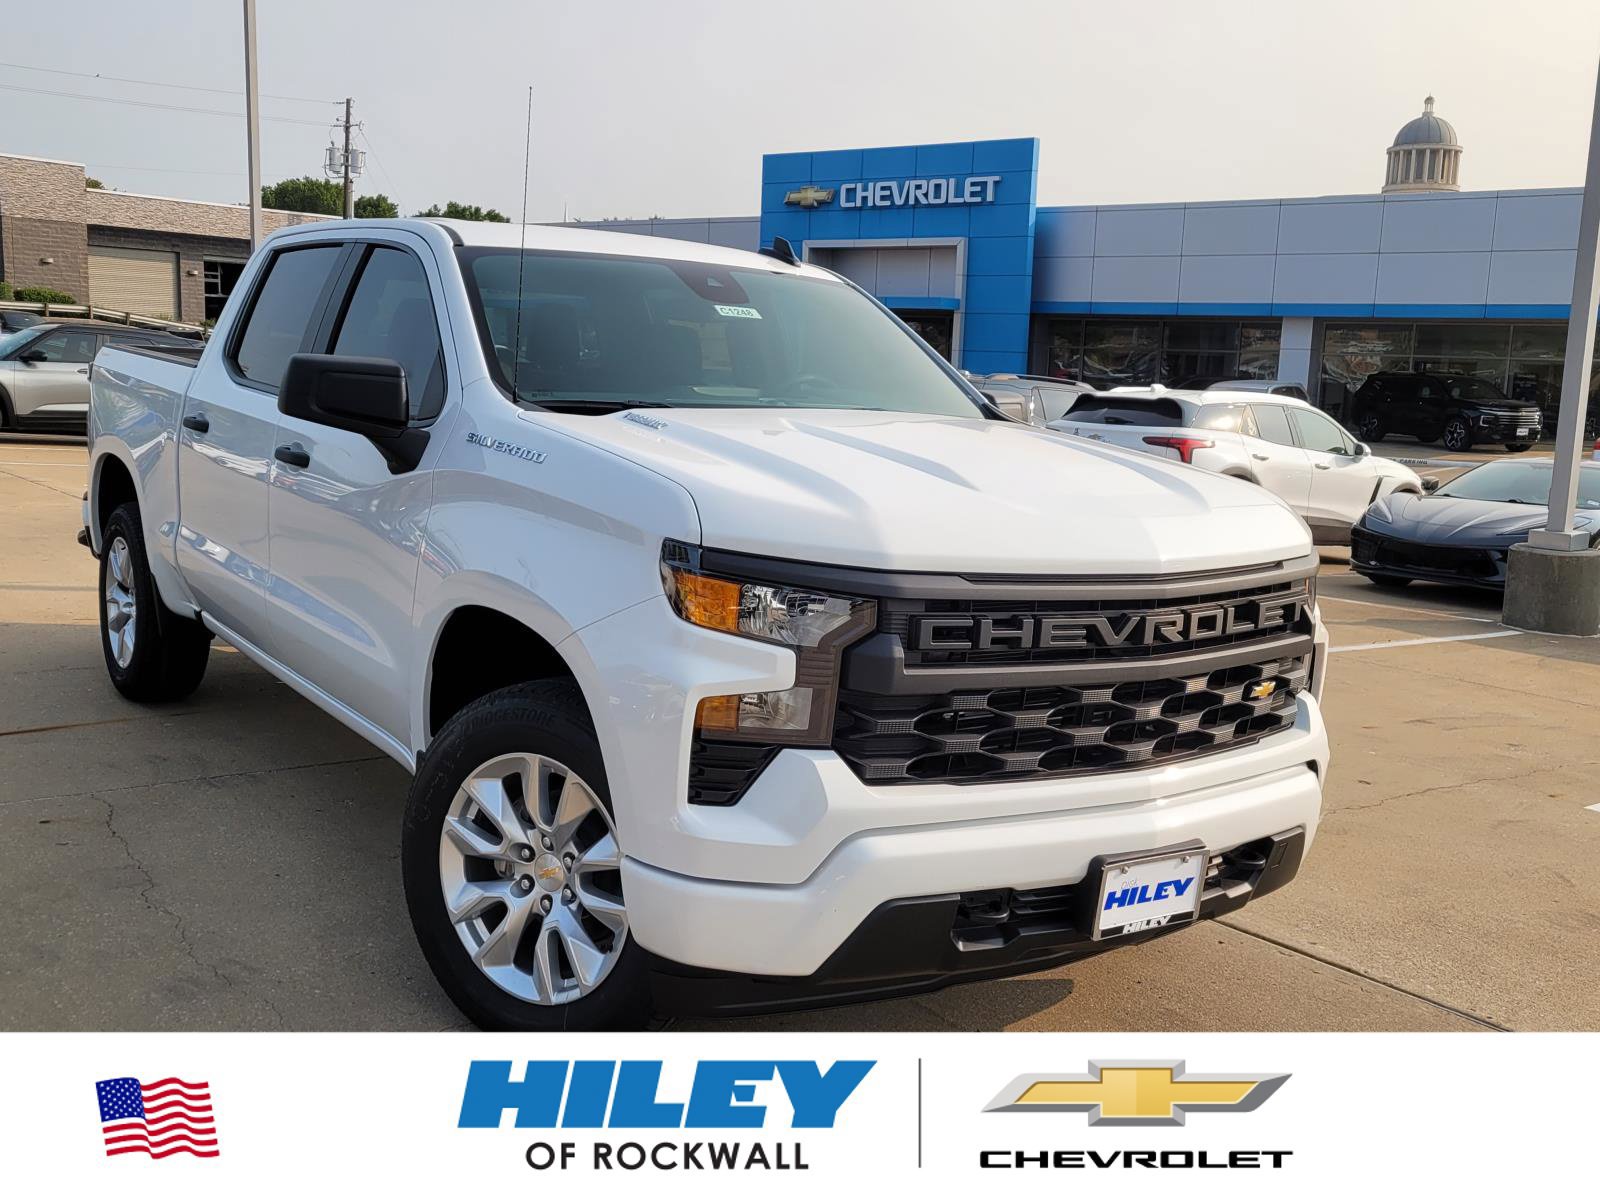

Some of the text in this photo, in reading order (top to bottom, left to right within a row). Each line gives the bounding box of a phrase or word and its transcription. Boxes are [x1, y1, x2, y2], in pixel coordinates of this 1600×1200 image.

[839, 175, 1002, 208] CHEVROLET
[465, 432, 548, 464] SILVERADO
[918, 597, 1309, 650] CHEVROLET
[1103, 876, 1195, 911] HILEY
[1122, 914, 1172, 934] HILEY
